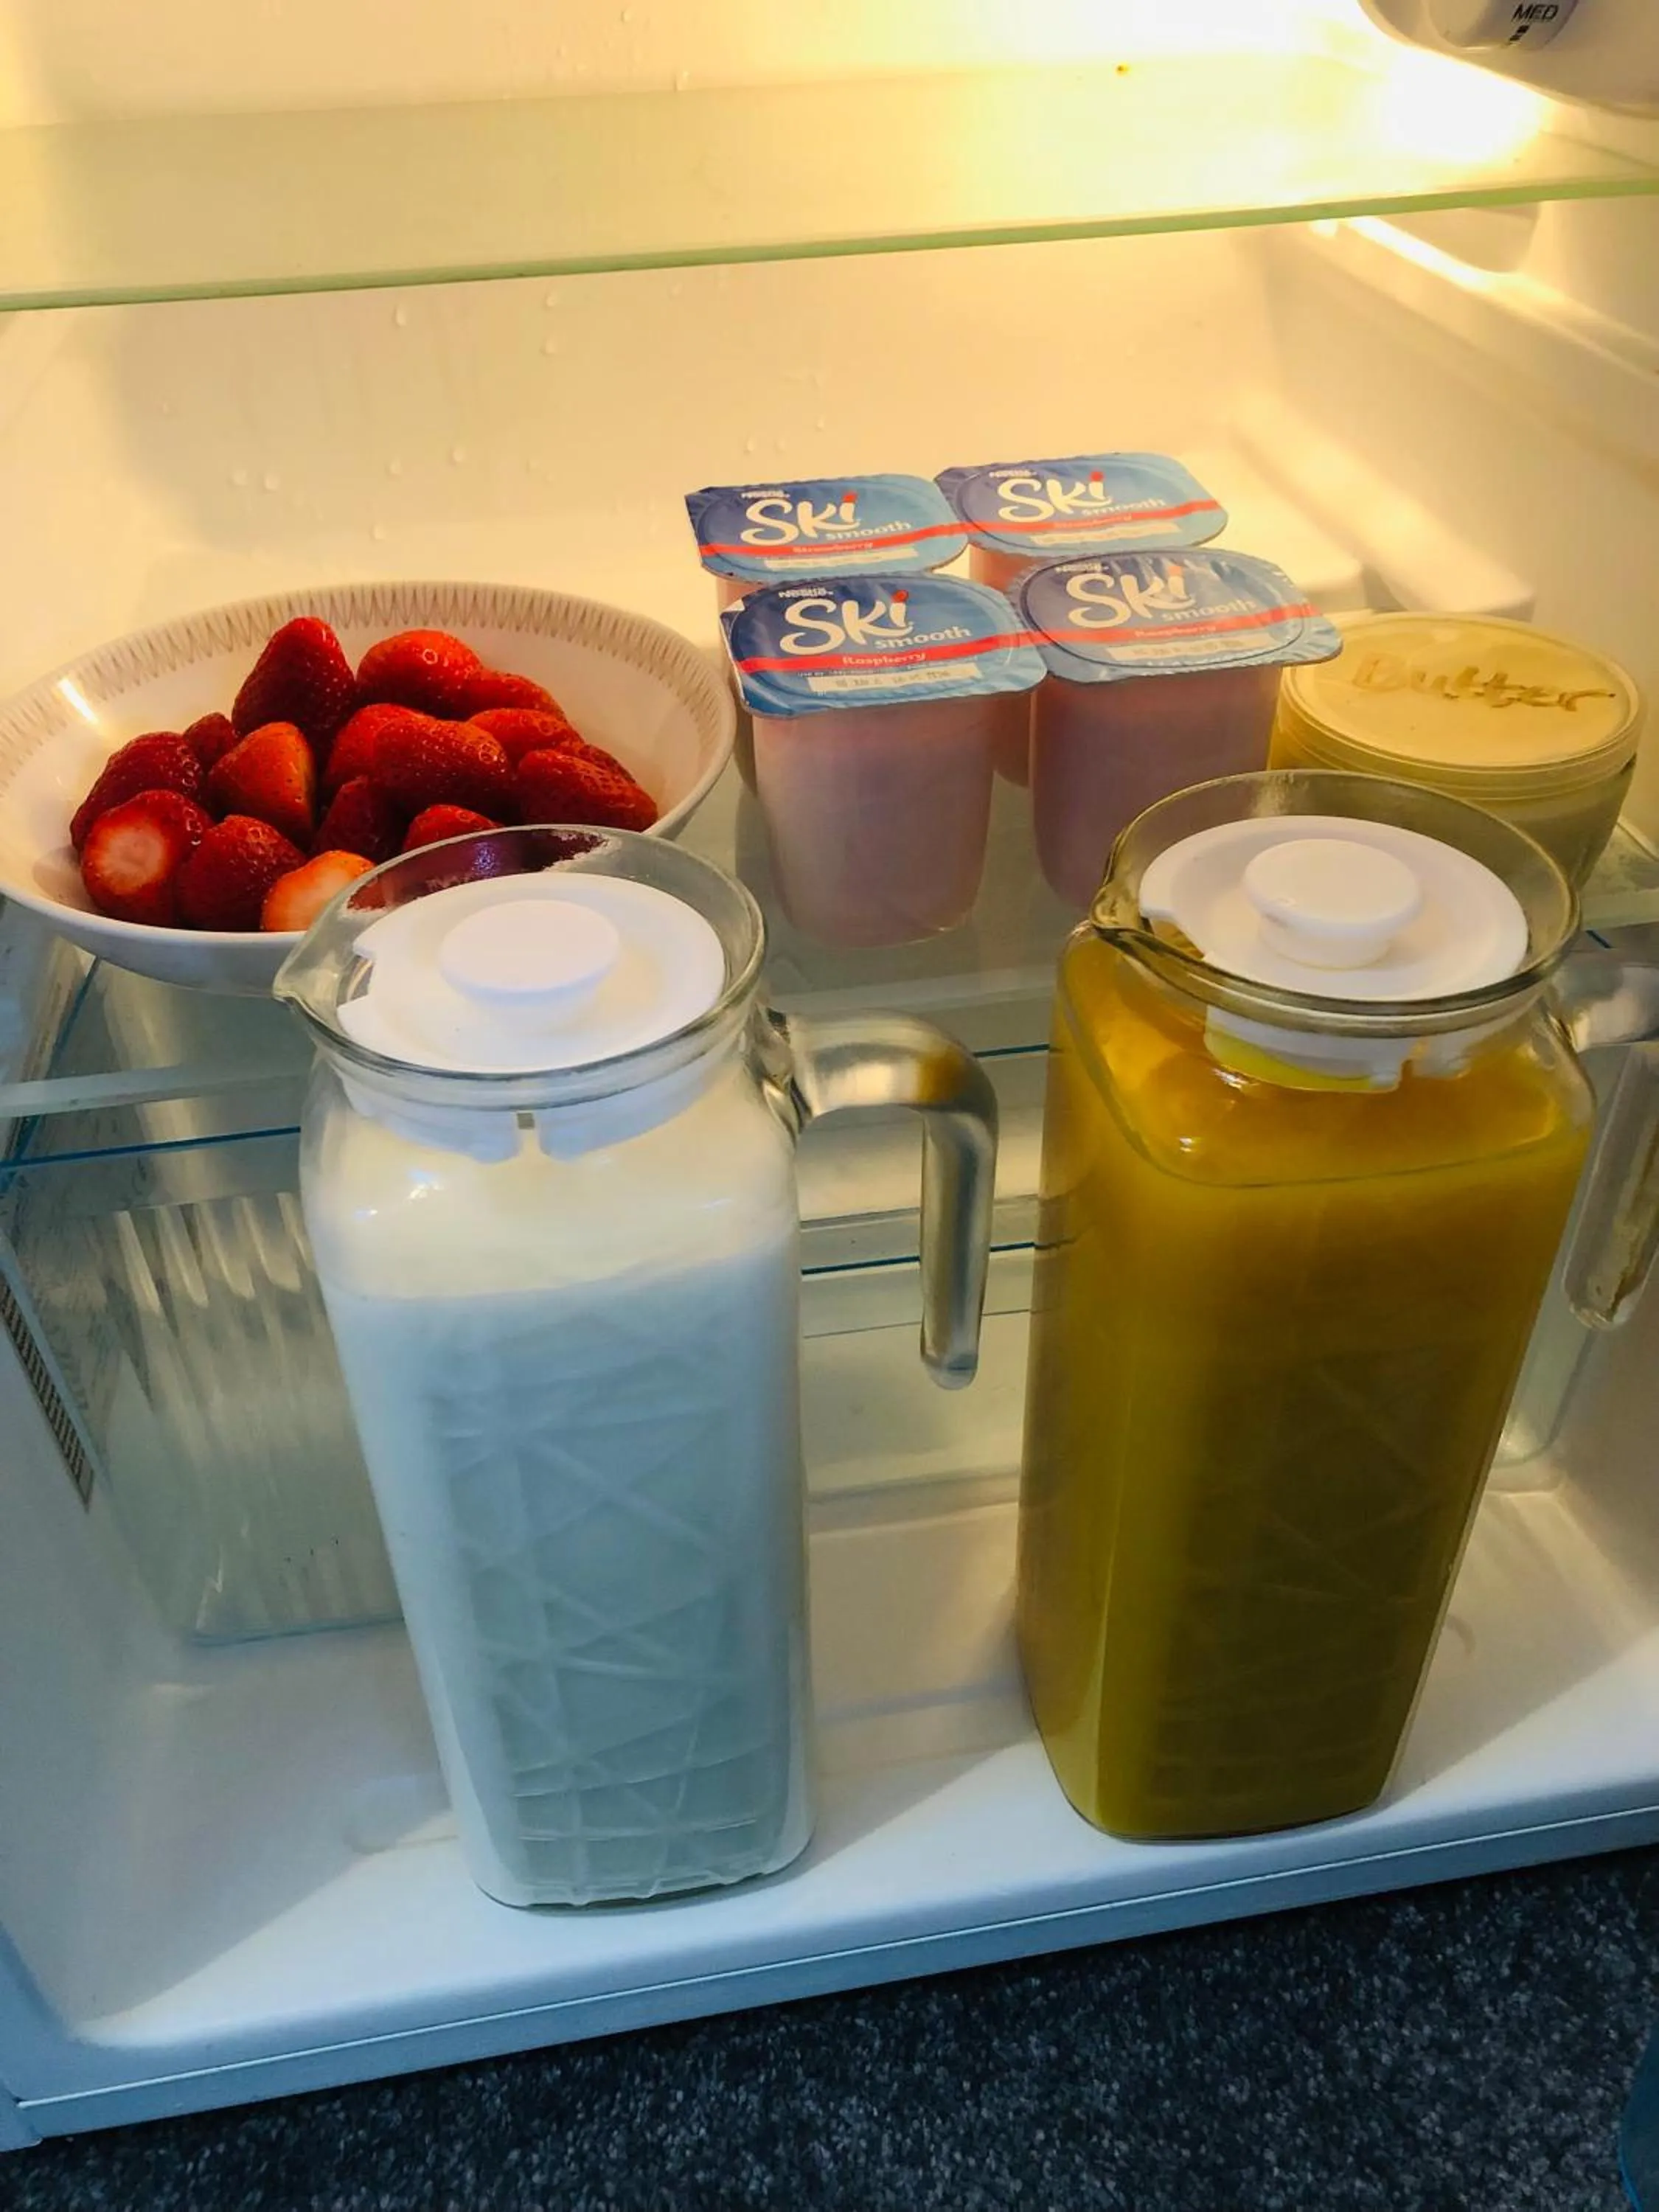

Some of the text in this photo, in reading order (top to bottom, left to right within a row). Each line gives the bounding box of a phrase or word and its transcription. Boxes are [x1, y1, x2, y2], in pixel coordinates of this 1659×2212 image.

[1510, 3, 1559, 23] MED
[824, 521, 913, 541] smooth
[1161, 599, 1258, 622] smooth
[874, 625, 973, 650] smooth
[842, 651, 926, 666] Raspberry
